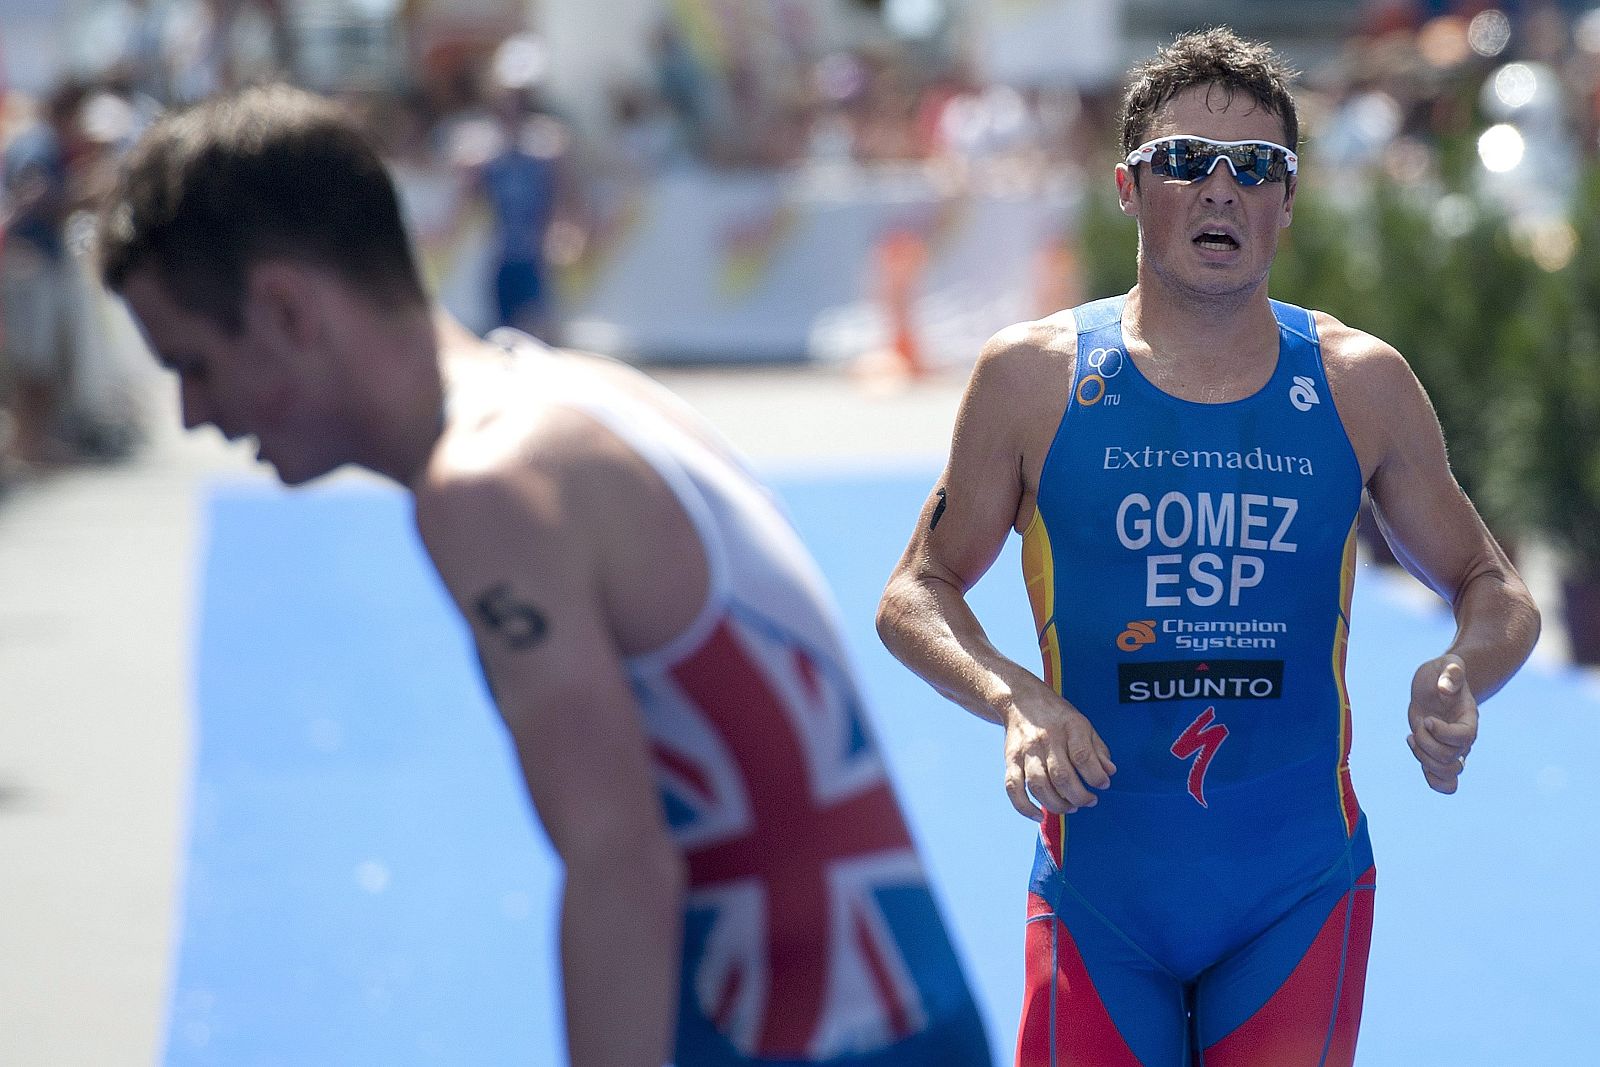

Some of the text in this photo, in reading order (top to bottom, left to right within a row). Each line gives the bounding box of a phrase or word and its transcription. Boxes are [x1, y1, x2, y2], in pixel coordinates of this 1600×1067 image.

[1103, 393, 1121, 406] ITU
[1103, 446, 1314, 476] Extremadura
[1115, 491, 1299, 553] GOMEZ
[1145, 552, 1266, 607] ESP
[1162, 619, 1287, 634] Champion
[1175, 635, 1276, 652] System
[1128, 677, 1274, 701] SUUNTO
